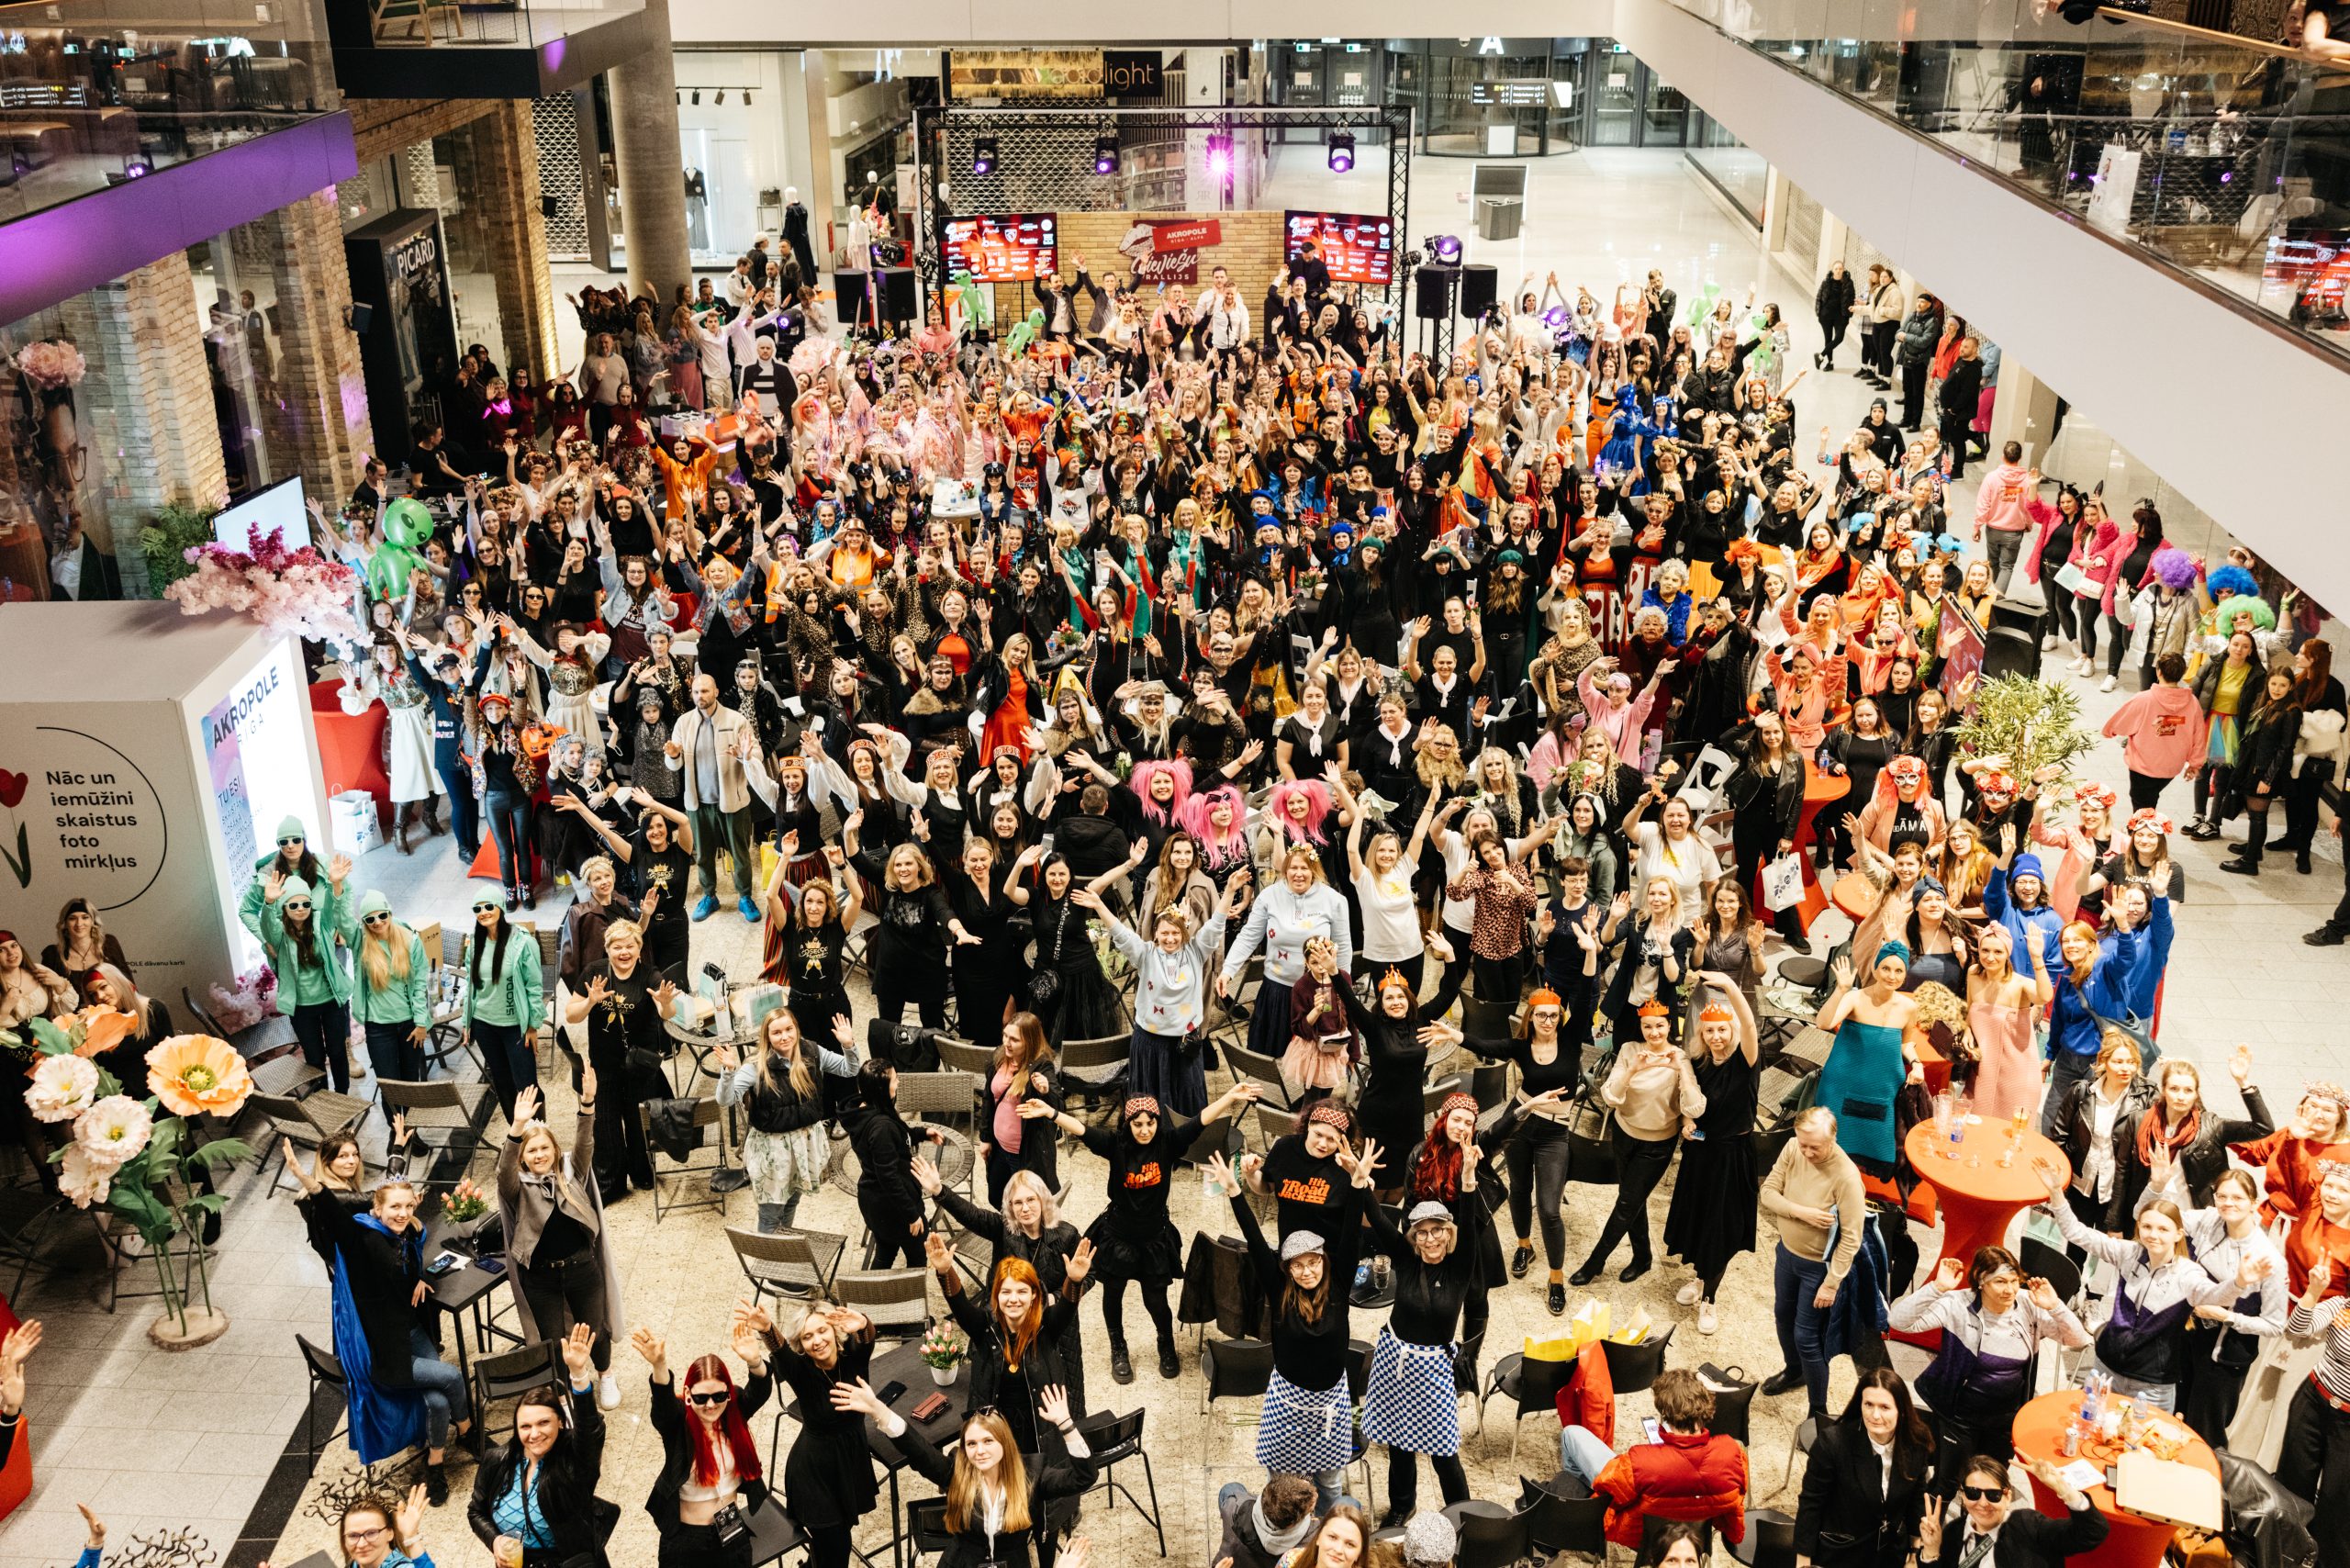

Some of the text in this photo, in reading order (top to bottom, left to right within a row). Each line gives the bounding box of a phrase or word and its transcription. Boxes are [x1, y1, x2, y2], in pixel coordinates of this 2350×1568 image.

[1167, 228, 1207, 240] AKROPOLE
[397, 238, 436, 278] PICARD
[214, 666, 279, 749] AKROPOLE
[46, 770, 116, 785] Nāc un
[50, 790, 134, 806] iemūžini
[56, 812, 138, 827] skaistus
[60, 834, 100, 847] foto
[65, 854, 138, 873] mirkļus
[599, 1000, 635, 1010] PROECCO
[1286, 1180, 1331, 1197] Road
[1308, 1177, 1326, 1187] Hit
[1278, 1183, 1306, 1202] Jack
